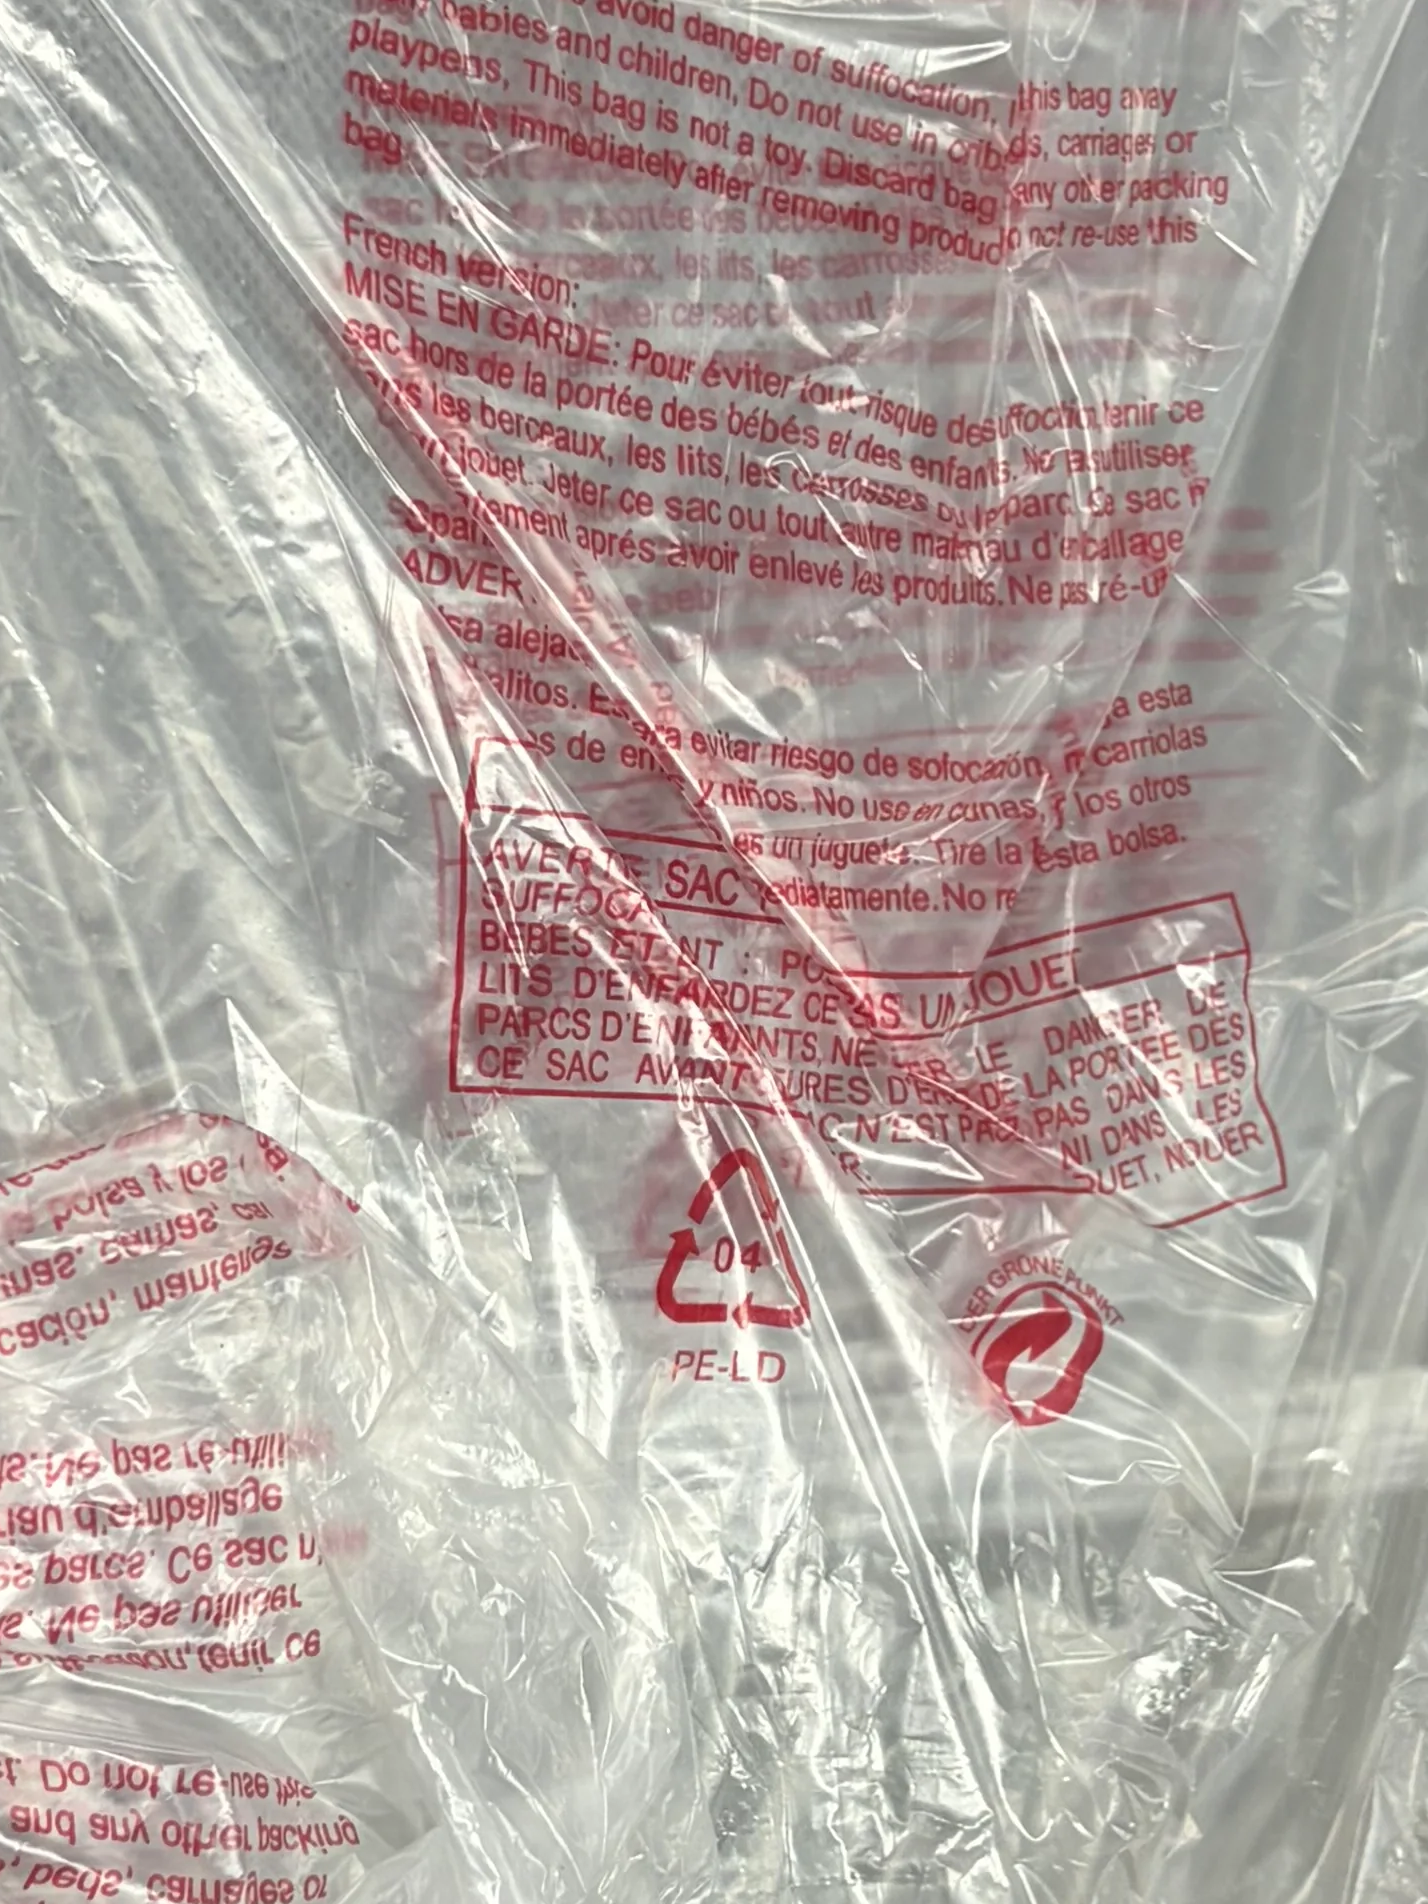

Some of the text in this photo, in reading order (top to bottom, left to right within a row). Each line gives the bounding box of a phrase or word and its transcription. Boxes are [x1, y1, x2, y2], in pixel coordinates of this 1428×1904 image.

[556, 26, 611, 64] and
[618, 41, 738, 107] children,
[747, 77, 789, 118] Do
[798, 98, 842, 129] not
[853, 113, 903, 148] use
[912, 118, 937, 157] in
[1166, 128, 1198, 154] or
[683, 10, 785, 66] danger
[793, 46, 825, 77] of
[831, 55, 997, 125] suffocation,
[1066, 83, 1111, 117] bag
[346, 67, 497, 133] materials
[510, 106, 687, 189] immediately
[694, 161, 755, 203] after
[761, 184, 900, 243] removing
[1072, 218, 1139, 247] re-use
[1147, 215, 1198, 246] this
[349, 18, 1230, 225] playpens, This bag is not a toy. Discard bag packing
[344, 211, 447, 276] French
[457, 246, 579, 309] version:
[345, 262, 1205, 439] MISE EN GARDE: Pour éviter risque ce
[342, 316, 1018, 492] sac hors de la portée des bébés et des enfants.
[432, 382, 1180, 513] les berceaux, les lits, les sac
[542, 464, 902, 553] Jeter ce sac ou tout autre
[576, 522, 1052, 605] aprés avoir enlevé les Ne
[1138, 682, 1193, 712] esta
[567, 731, 1191, 823] de niños. No use en los otros
[691, 724, 1209, 778] evitar riesgo de carriolas
[772, 823, 1187, 865] un Tire la bolsa.
[941, 883, 985, 913] No
[478, 1047, 608, 1083] CE SAC
[479, 963, 1167, 1170] LITS NI DANS
[480, 919, 1248, 1137] BEBES PAS LES
[803, 990, 838, 1026] CE
[1025, 1066, 1066, 1100] LA
[1187, 1013, 1244, 1049] DES
[975, 1040, 1012, 1075] LE
[478, 1004, 1264, 1172] PARCS NE NOUER
[672, 1349, 785, 1382] PE-LD
